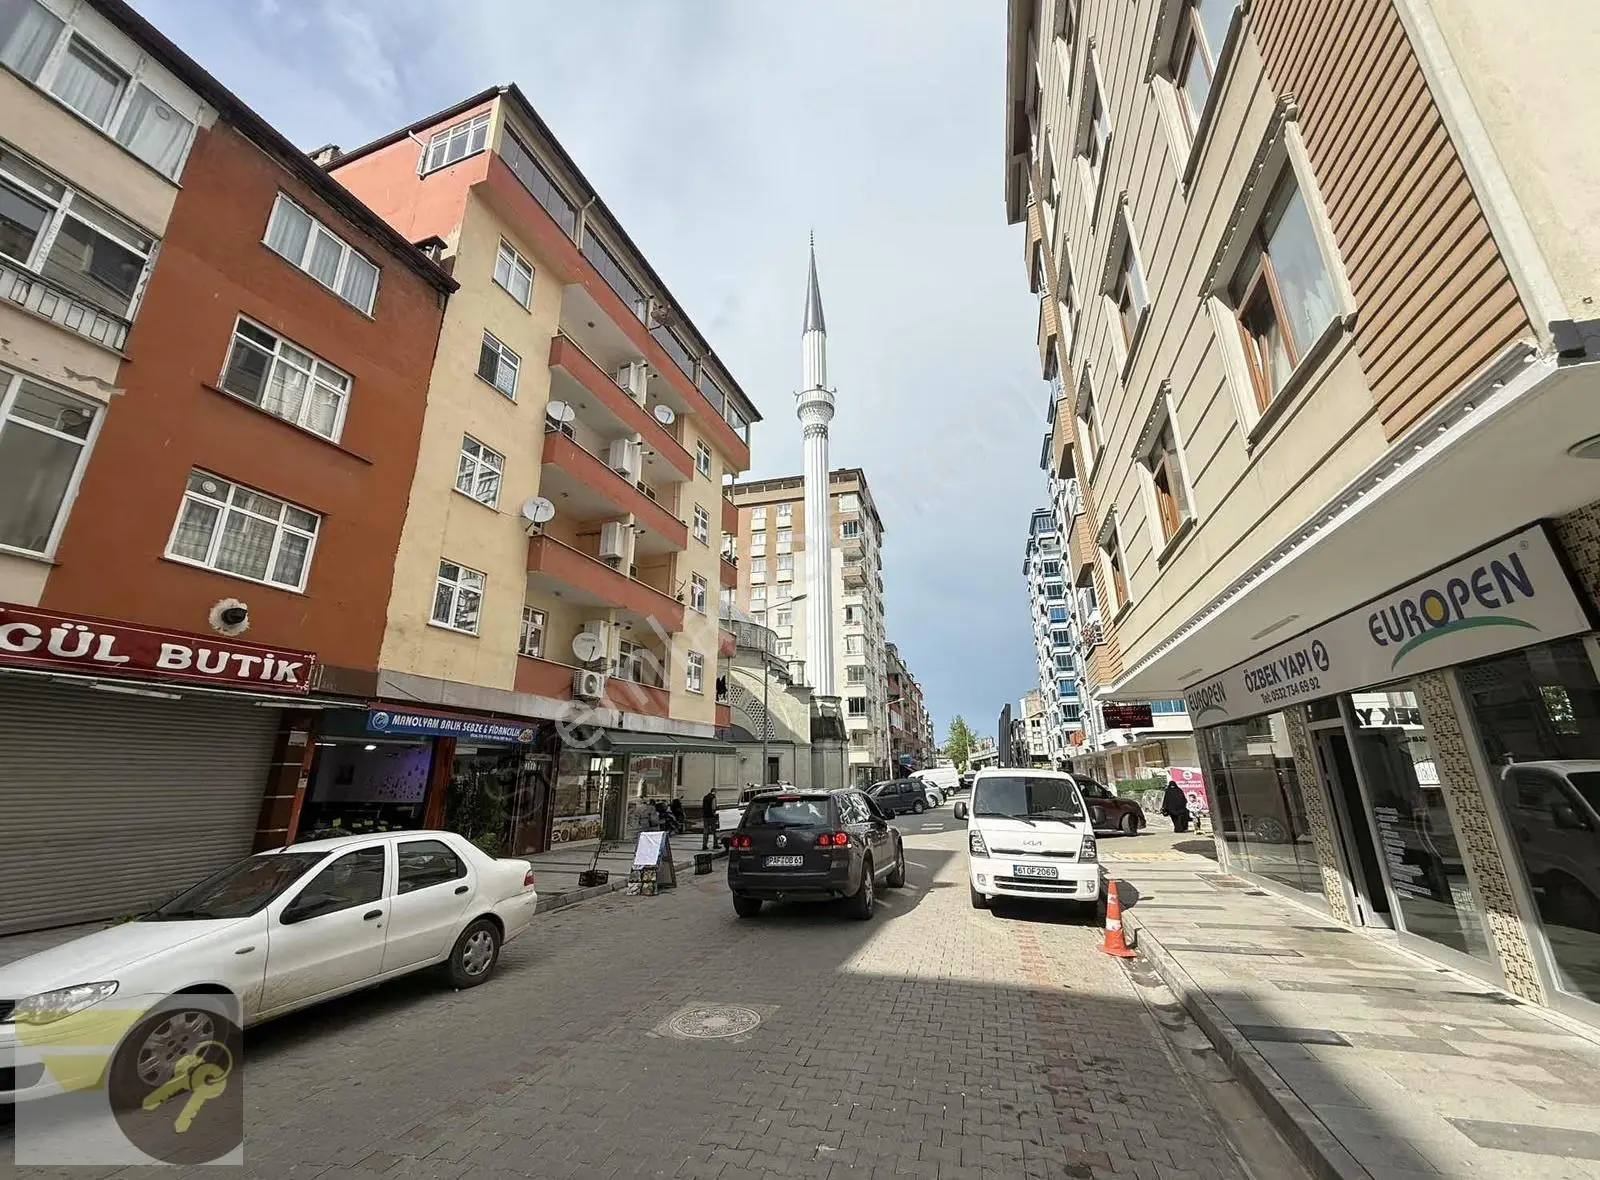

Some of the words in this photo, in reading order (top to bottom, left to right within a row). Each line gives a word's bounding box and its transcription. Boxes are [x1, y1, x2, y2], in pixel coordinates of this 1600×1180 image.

[1368, 552, 1535, 646] EUROPEN
[0, 622, 130, 664] GÜL
[156, 642, 303, 683] BUTİK
[1244, 663, 1281, 693] ÖZBEK
[1279, 649, 1313, 680] YAPI
[1188, 681, 1227, 711] EUROPEN
